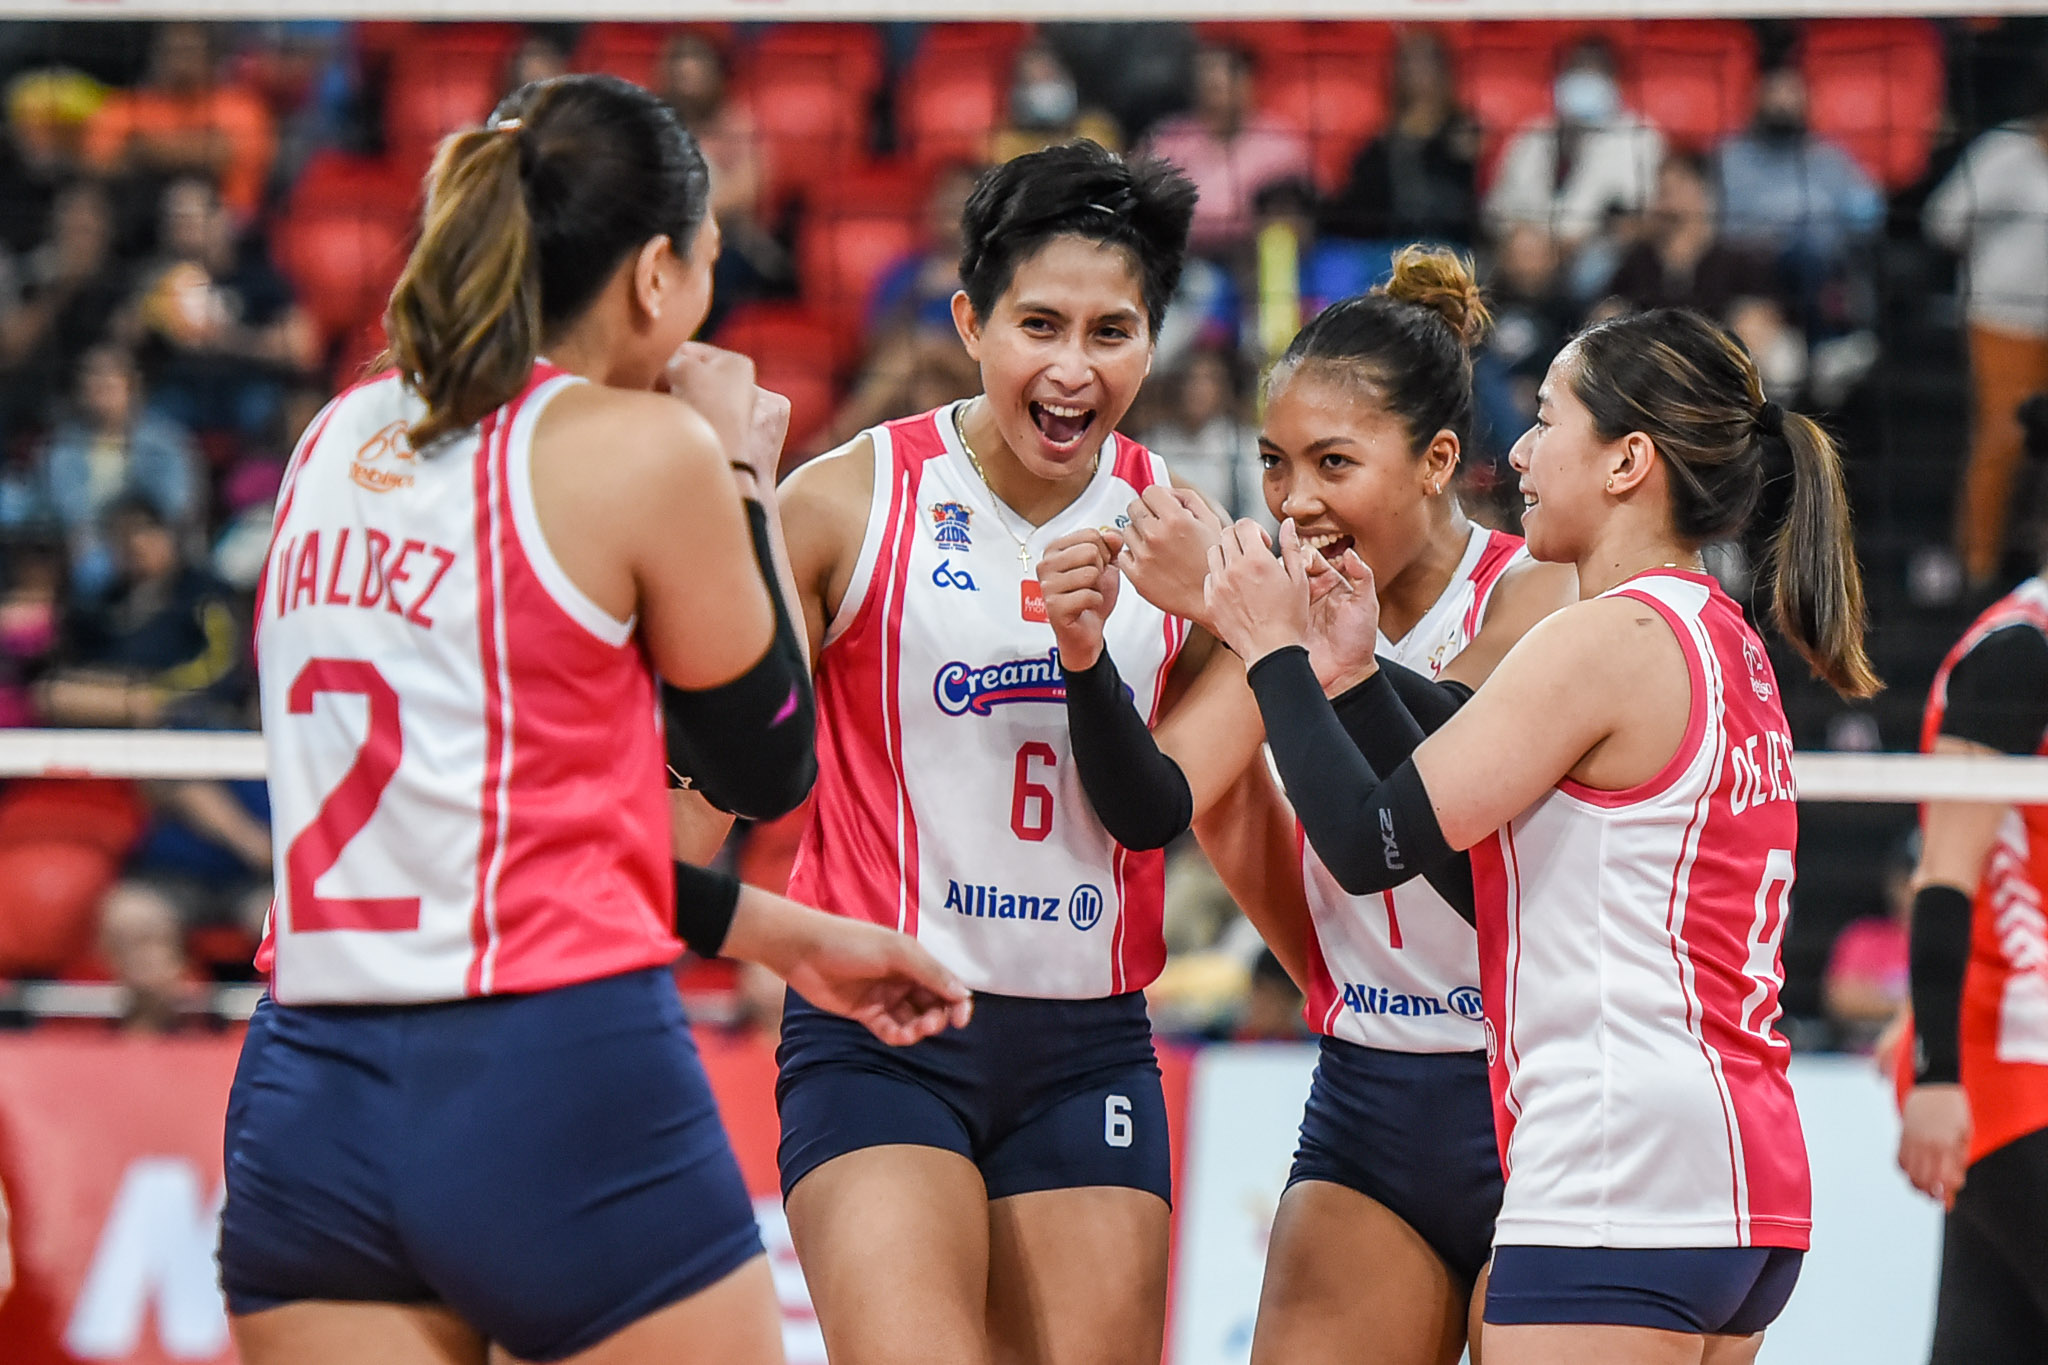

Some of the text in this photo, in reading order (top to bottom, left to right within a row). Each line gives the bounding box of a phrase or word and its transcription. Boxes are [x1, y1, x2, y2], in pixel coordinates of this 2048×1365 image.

[277, 527, 456, 630] VALDEZ
[1024, 605, 1049, 614] mon
[937, 650, 1063, 713] Creaml
[285, 656, 421, 934] 2
[1010, 741, 1057, 842] 6
[1730, 730, 1799, 817] DE JES
[1378, 808, 1405, 870] 2XU
[943, 878, 1061, 922] Allianz
[1343, 982, 1449, 1016] Allianz
[1104, 1094, 1133, 1148] 6
